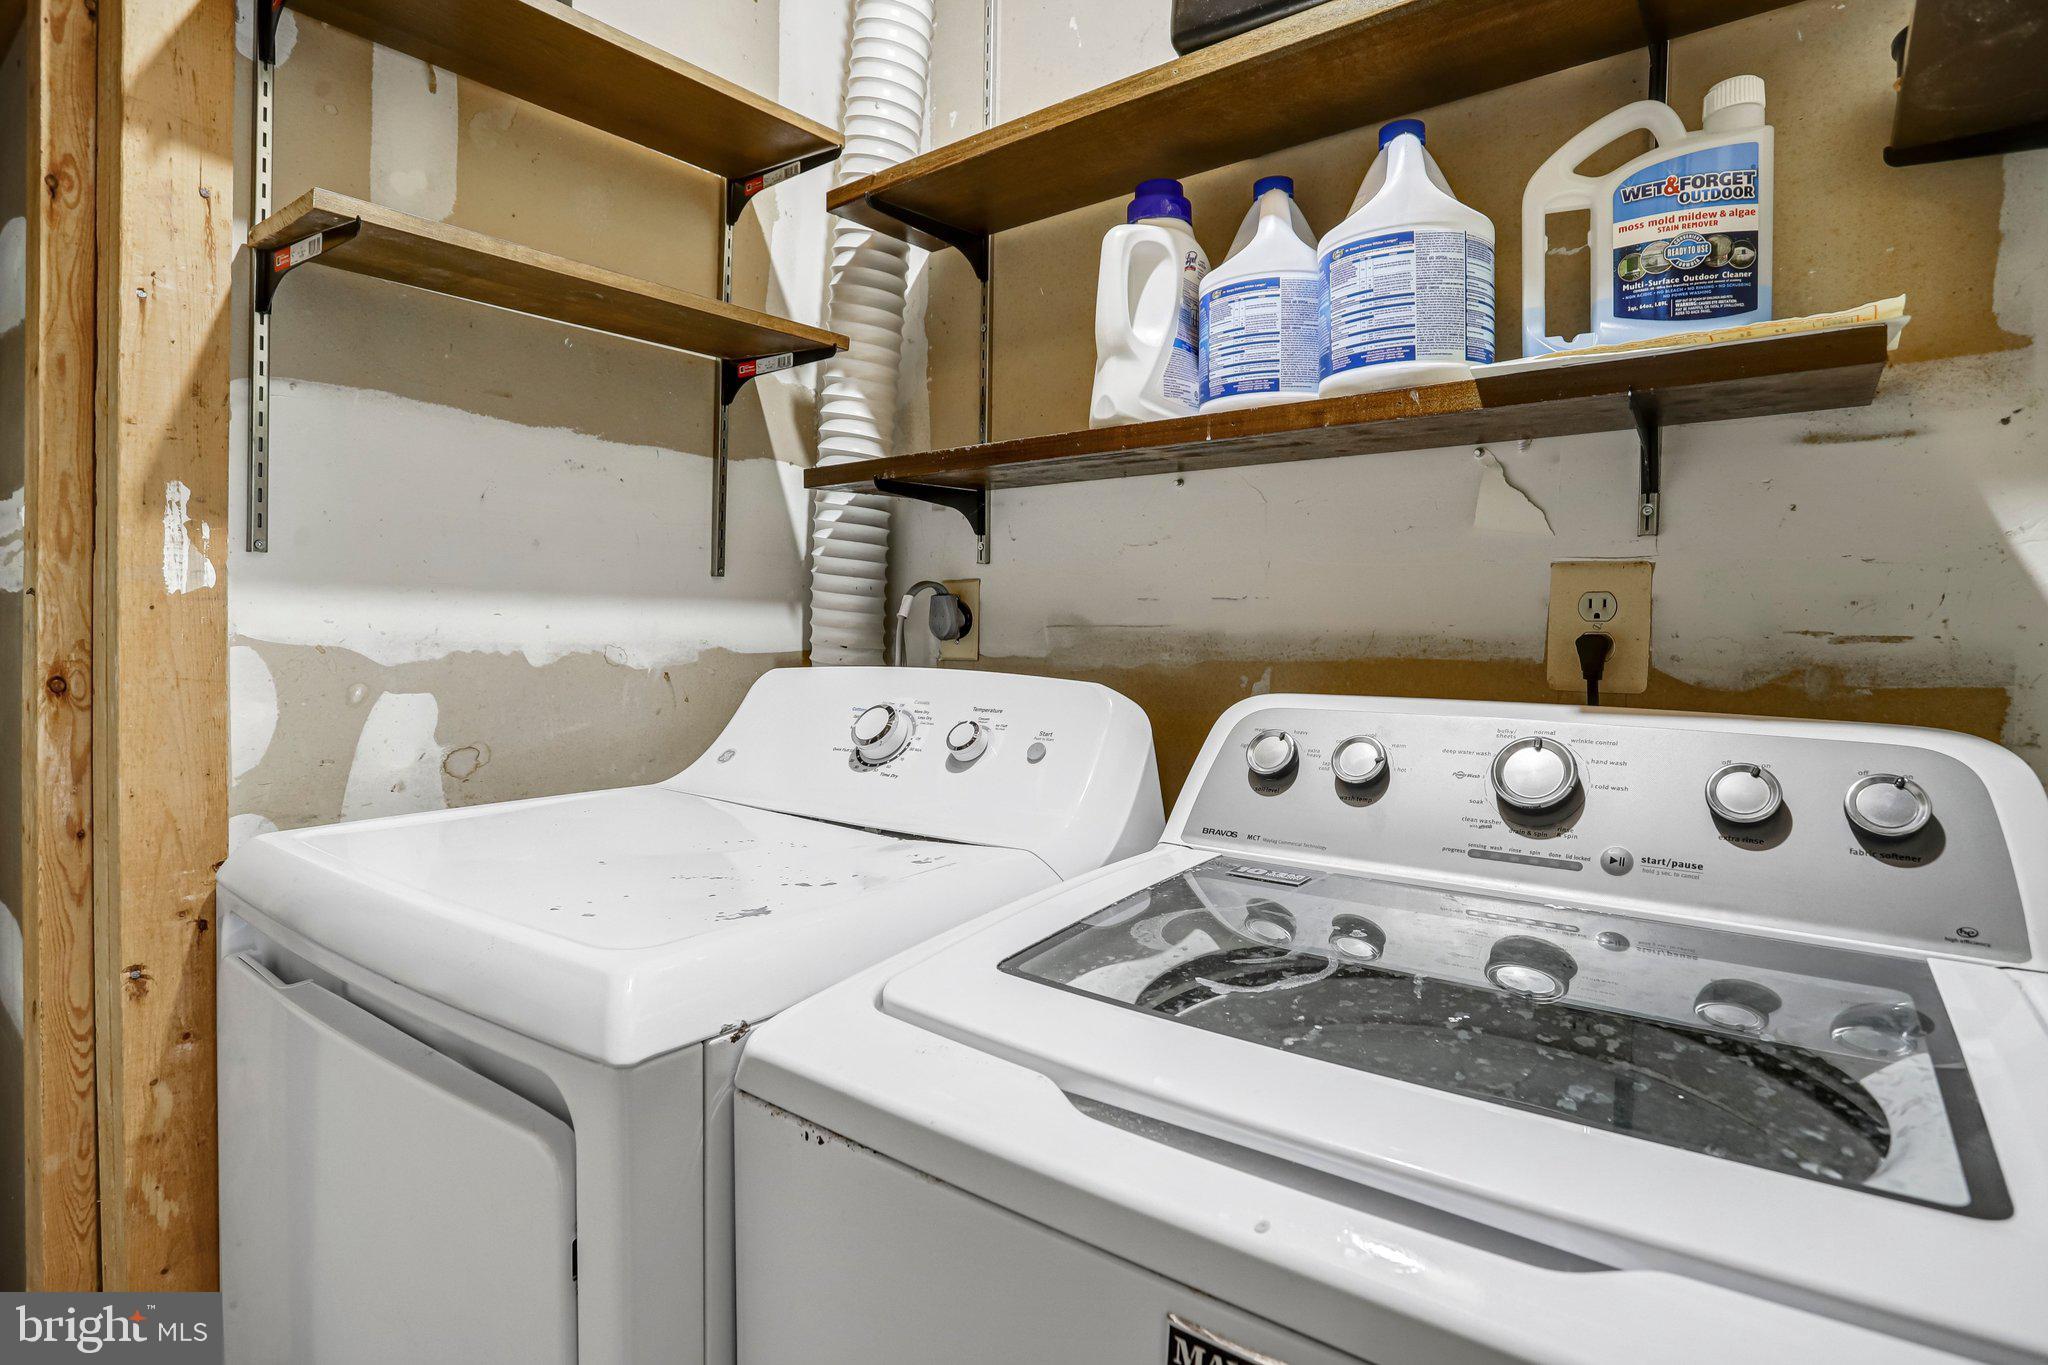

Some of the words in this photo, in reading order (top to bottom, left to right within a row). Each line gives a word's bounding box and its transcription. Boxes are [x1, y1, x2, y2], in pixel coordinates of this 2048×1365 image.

[1678, 186, 1754, 204] OUTDOOR
[1618, 222, 1645, 234] moss
[1648, 215, 1675, 228] mold
[1678, 210, 1717, 222] mildew
[1720, 209, 1726, 217] &
[1729, 208, 1756, 218] algae
[1657, 225, 1680, 234] STAIN
[1681, 220, 1718, 231] REMOVER
[1667, 246, 1688, 257] READY
[1688, 246, 1696, 254] TO
[1697, 244, 1709, 253] USE
[1622, 278, 1680, 292] Multi-Surface
[1683, 274, 1719, 283] Outdoor
[1722, 271, 1752, 279] Cleaner
[973, 706, 1003, 714] Temperature
[1039, 730, 1053, 738] Start
[1595, 739, 1618, 747] control
[1590, 758, 1608, 766] hand
[1594, 783, 1611, 791] cold
[1202, 827, 1238, 839] BRAVOS
[1534, 830, 1548, 838] spin
[1564, 832, 1578, 840] spin
[1718, 835, 1740, 843] extra
[1741, 836, 1765, 845] rinse
[1442, 846, 1466, 854] progress
[1468, 842, 1487, 850] sensing
[1849, 847, 1877, 858] fabric
[1879, 851, 1922, 863] softener
[1641, 856, 1704, 871] start/pause
